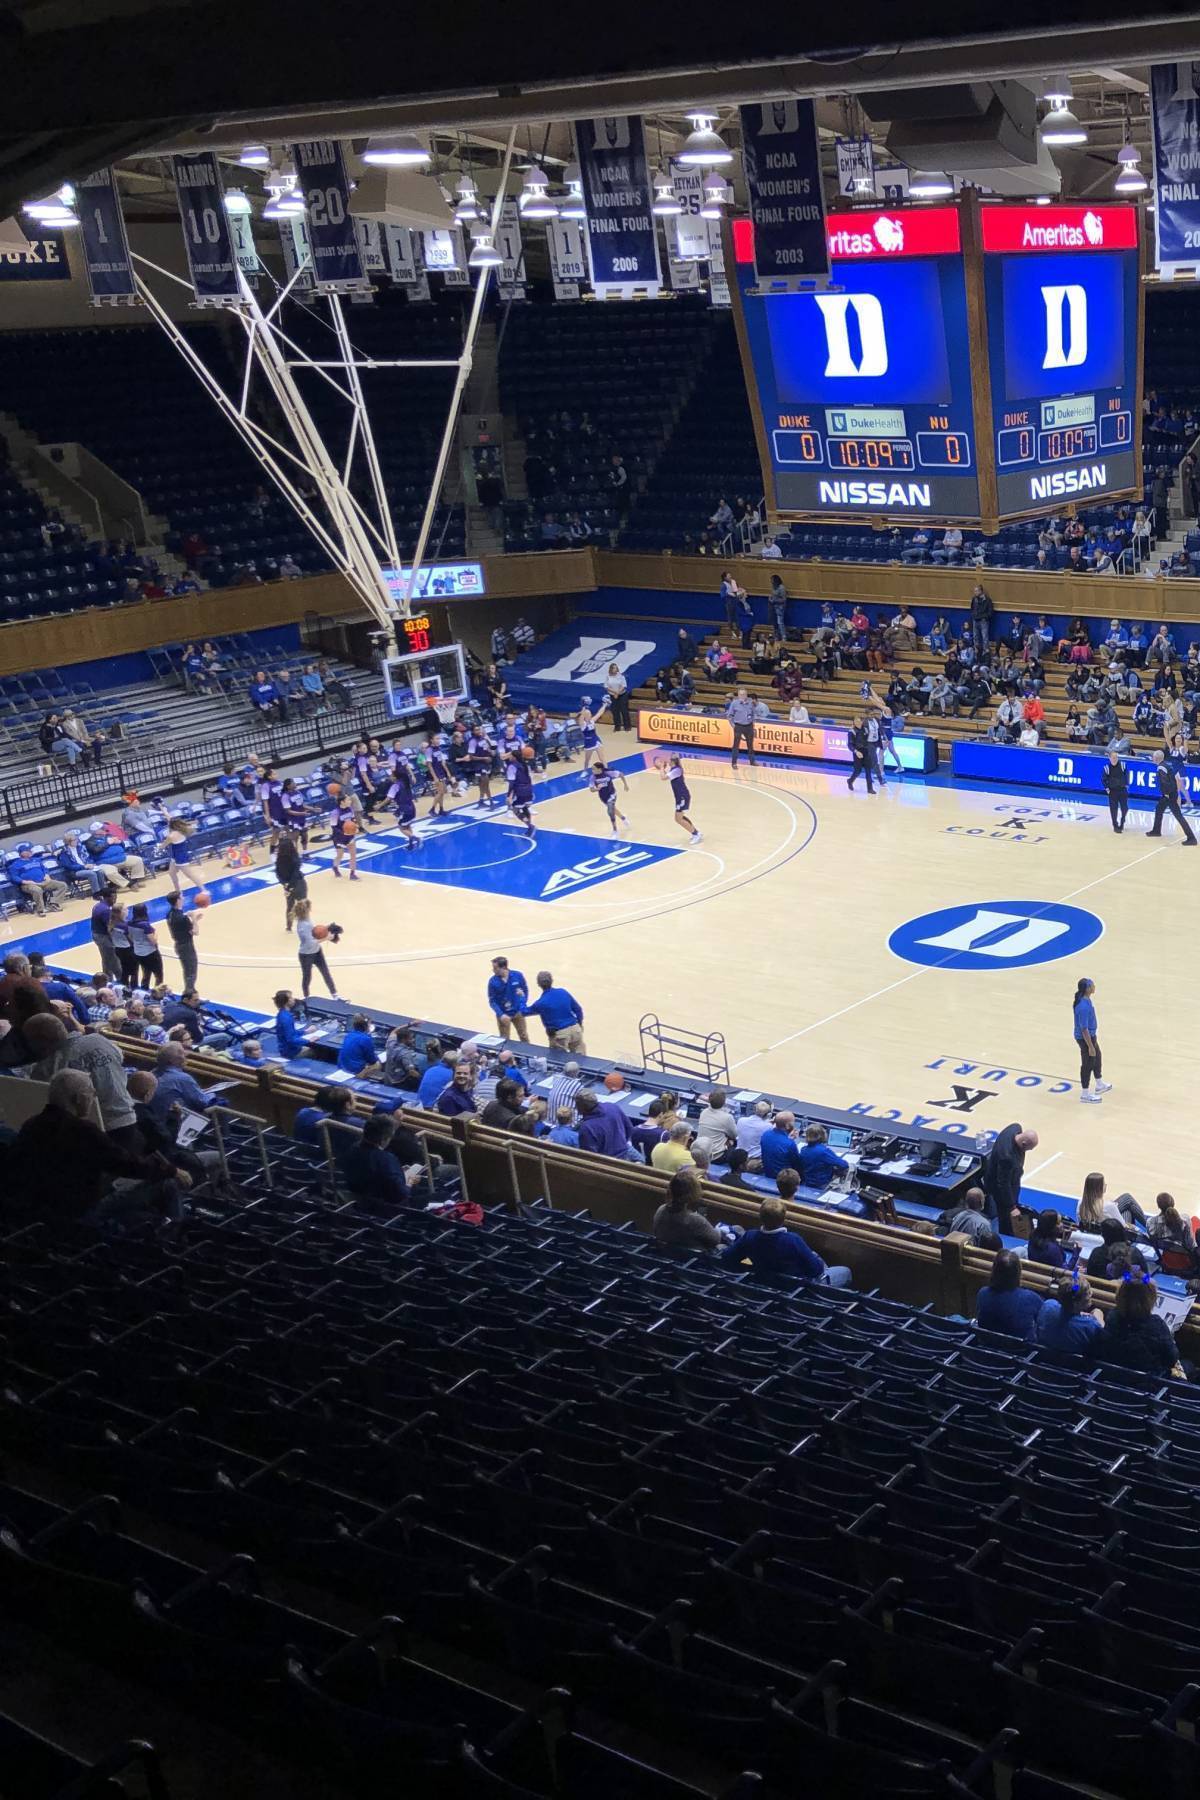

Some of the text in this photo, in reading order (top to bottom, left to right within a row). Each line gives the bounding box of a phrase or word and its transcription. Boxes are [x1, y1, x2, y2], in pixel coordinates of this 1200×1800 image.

[300, 140, 336, 166] BEARD
[766, 151, 797, 169] NCAA
[600, 166, 630, 183] NCAA
[757, 179, 811, 197] WOMEN'S
[1161, 183, 1199, 202] FINAL
[308, 187, 345, 226] 20
[591, 192, 642, 208] WOMEN'S
[94, 208, 108, 243] 1
[188, 208, 221, 243] 10
[590, 216, 650, 234] FINAL FOUR
[755, 205, 821, 225] FINAL FOUR
[235, 228, 246, 249] 1
[362, 224, 372, 246] 1
[563, 232, 572, 254] 1
[1022, 222, 1086, 247] Ameritas
[396, 239, 406, 261] 1
[504, 237, 514, 259] 1
[775, 250, 804, 265] 2003
[561, 263, 580, 274] 2019
[612, 258, 639, 272] 2006
[813, 293, 889, 378] D
[1041, 284, 1088, 370] D
[1057, 405, 1093, 419] DukeHealth
[1109, 398, 1121, 411] NU
[779, 415, 811, 428] DUKE
[851, 418, 903, 429] DukeHealth
[930, 416, 948, 429] NU
[1004, 411, 1029, 426] DUKE
[1117, 415, 1126, 441] 0
[801, 434, 815, 460] 0
[840, 441, 894, 468] 10:09
[946, 435, 960, 463] 0
[1020, 431, 1029, 458] 0
[1048, 429, 1084, 458] 10:09
[1030, 464, 1106, 499] NISSAN
[819, 481, 932, 507] NISSAN
[404, 617, 430, 632] 10:08
[408, 630, 430, 652] 30
[648, 713, 711, 735] Continental
[667, 732, 701, 743] TIRE
[758, 742, 793, 754] TIRE
[1057, 758, 1074, 776] D
[945, 825, 1049, 844] COURT
[995, 817, 1042, 830] K
[541, 846, 649, 893] ACC
[923, 1057, 1073, 1094] COURT
[925, 1084, 999, 1113] K
